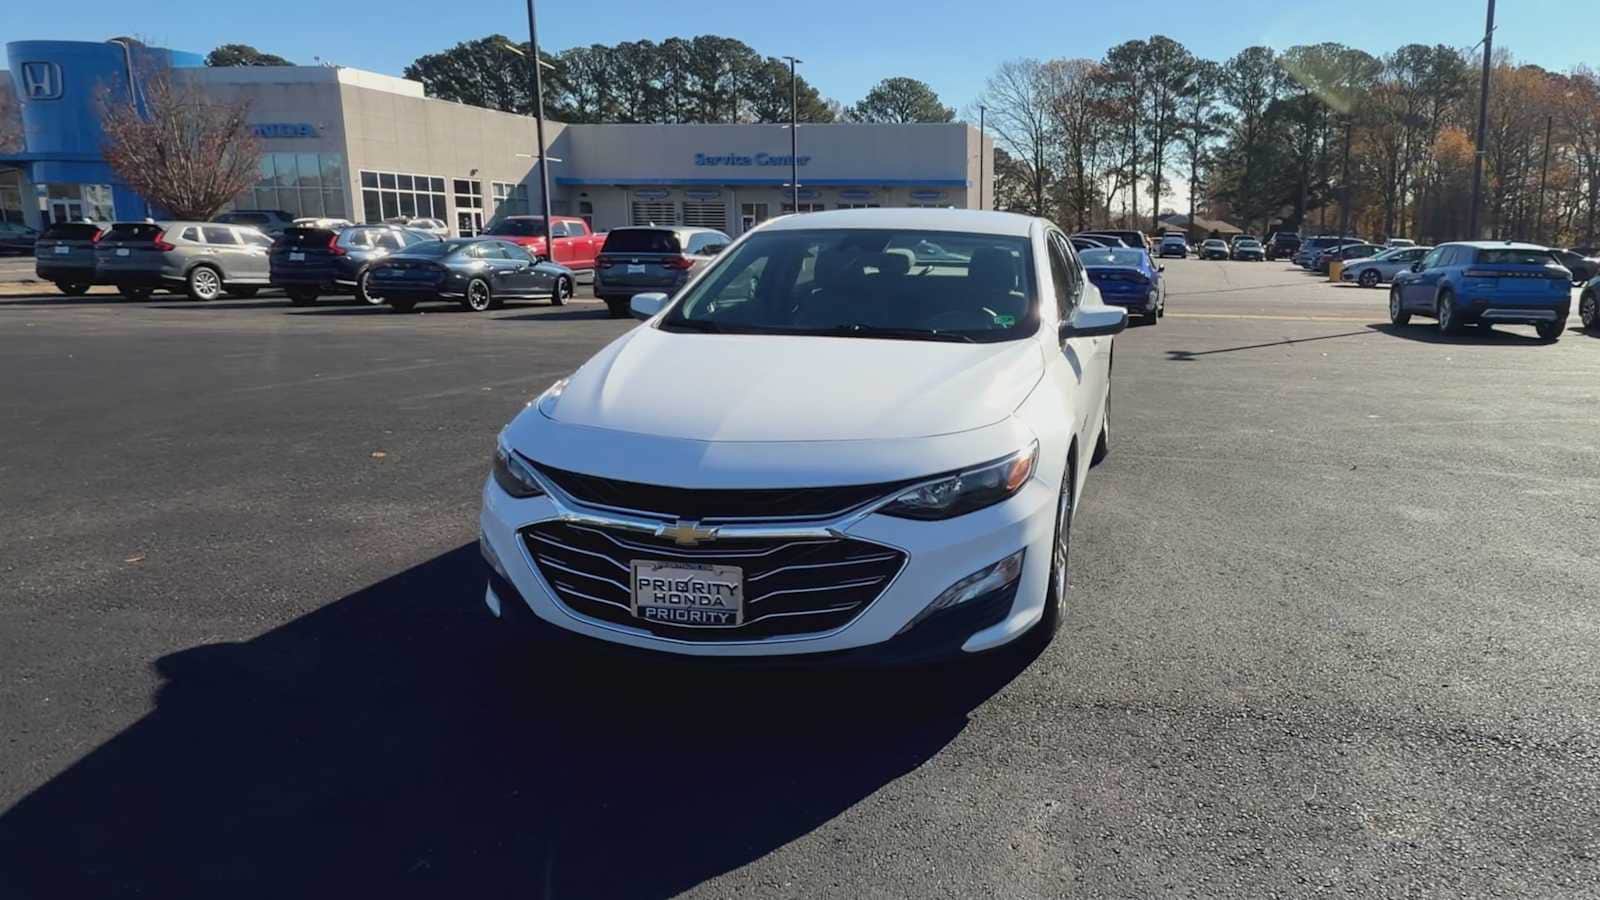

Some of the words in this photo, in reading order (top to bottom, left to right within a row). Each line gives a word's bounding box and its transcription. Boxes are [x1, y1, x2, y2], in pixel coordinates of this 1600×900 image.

[694, 152, 753, 166] Service
[638, 575, 738, 596] PRIORITY
[654, 592, 727, 608] HONDA
[645, 608, 729, 623] PRIORITY
